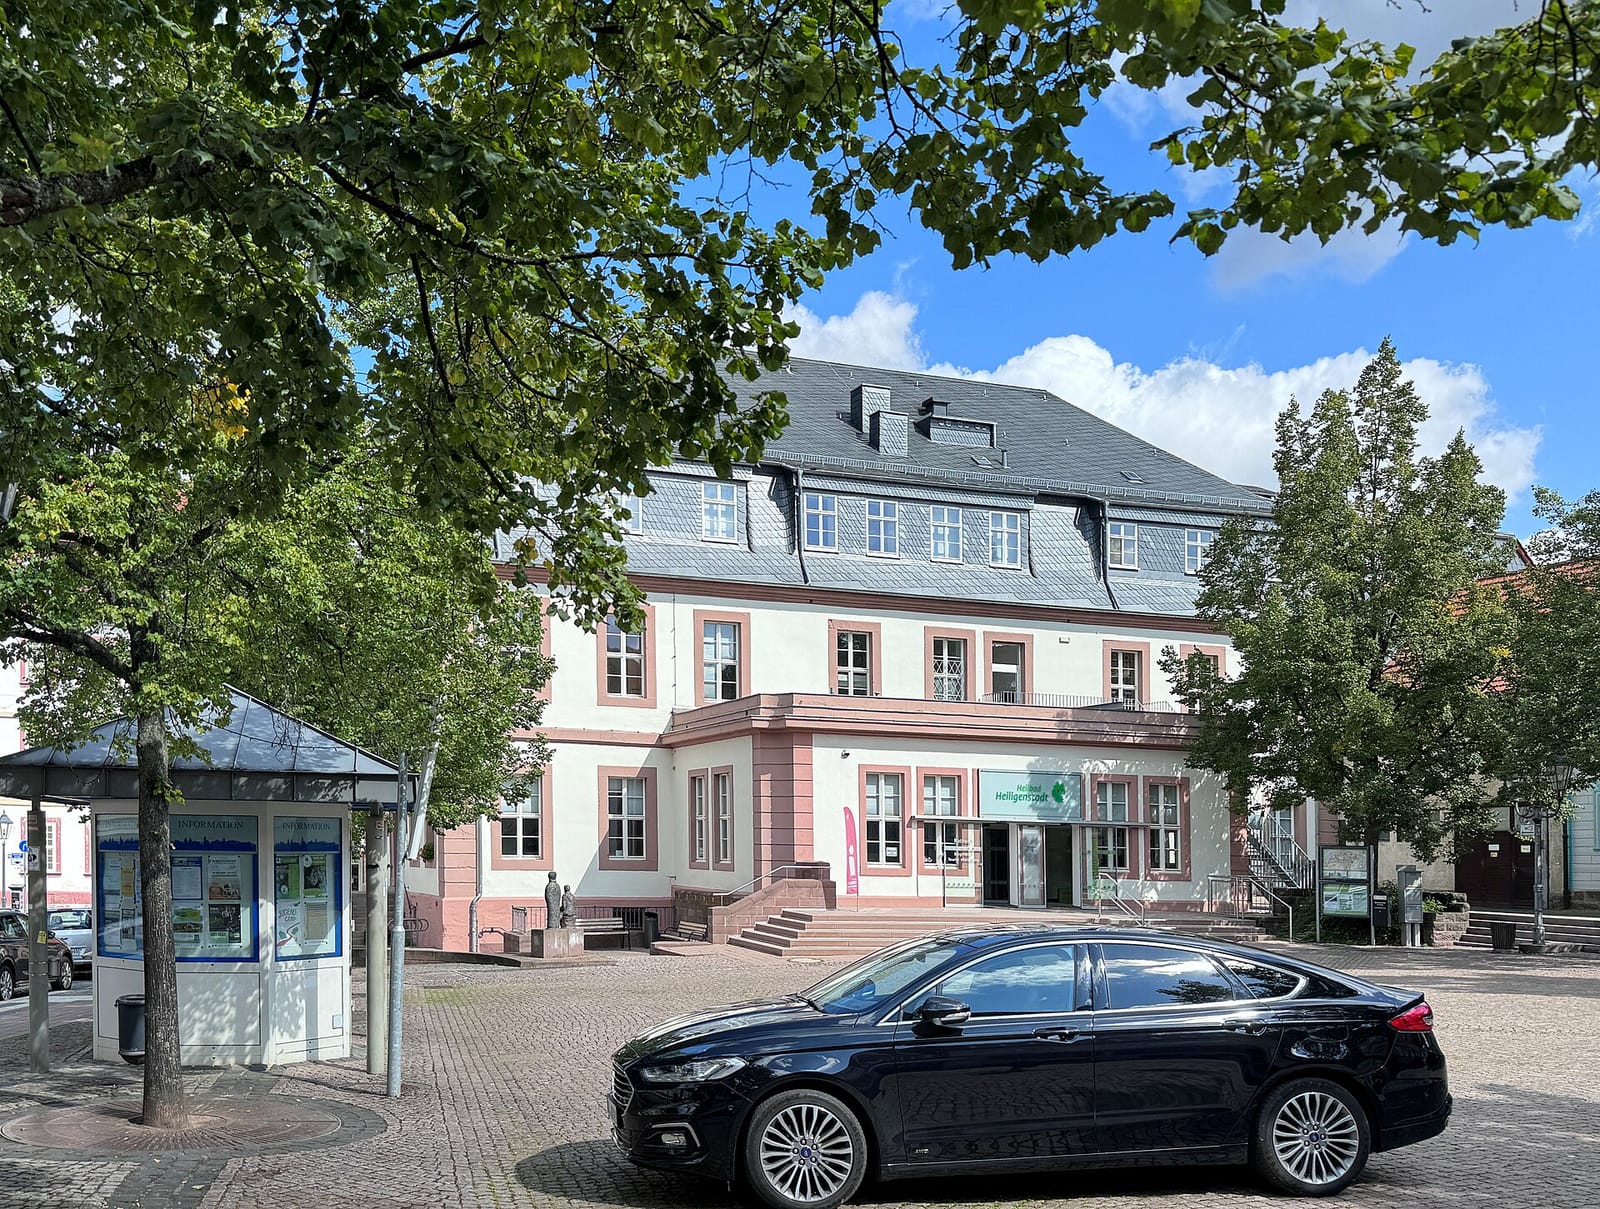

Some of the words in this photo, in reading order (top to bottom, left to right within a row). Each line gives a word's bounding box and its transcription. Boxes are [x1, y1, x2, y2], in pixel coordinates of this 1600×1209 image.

[995, 791, 1049, 803] Heiligenstadt
[178, 819, 245, 829] INFORMATION
[282, 821, 330, 831] INFORMATION
